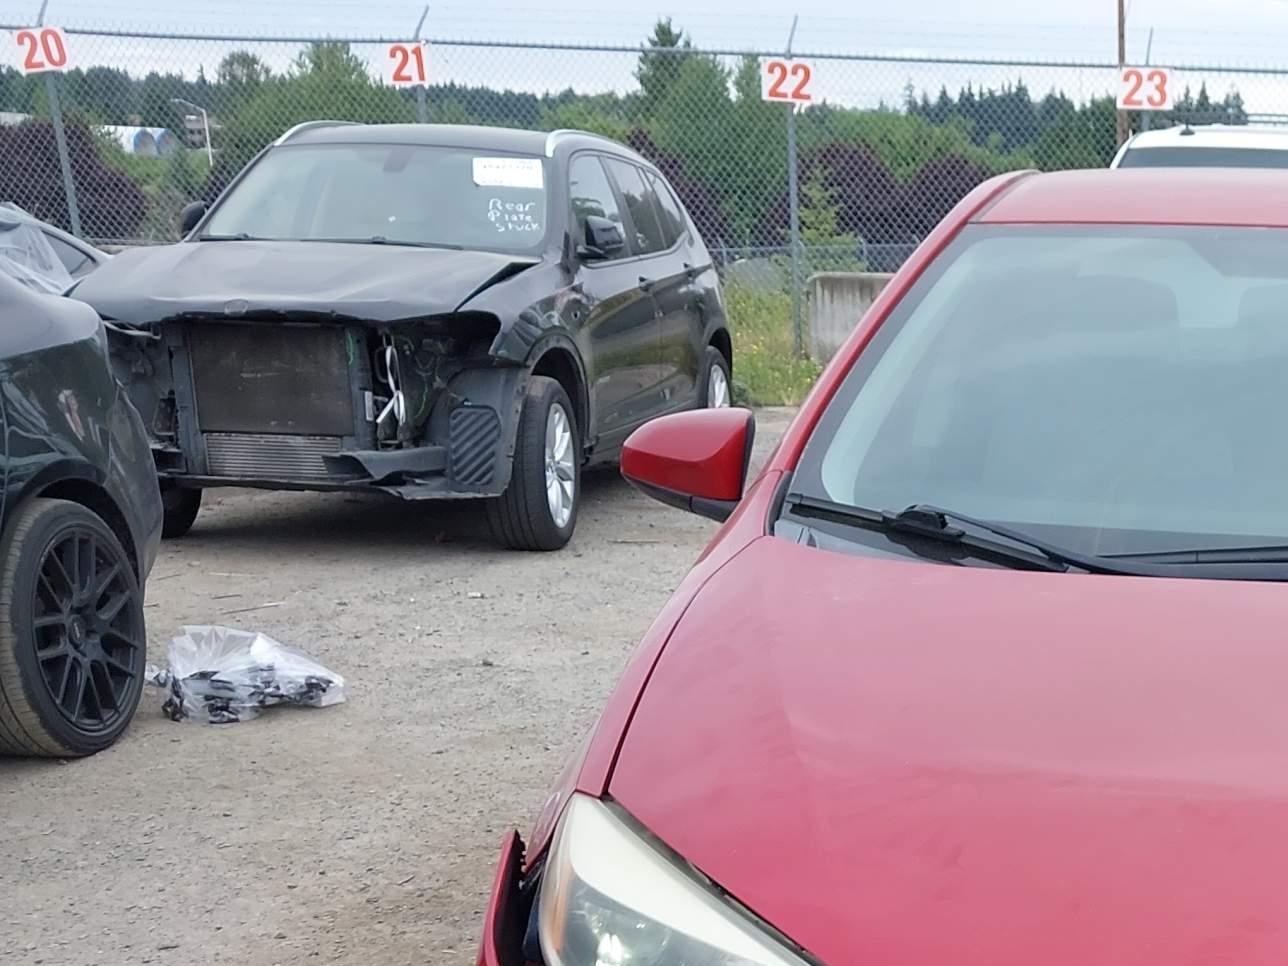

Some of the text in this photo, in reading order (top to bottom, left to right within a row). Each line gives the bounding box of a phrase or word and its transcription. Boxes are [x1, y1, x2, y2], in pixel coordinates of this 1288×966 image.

[16, 28, 66, 70] 20
[389, 45, 426, 83] 21
[767, 62, 812, 101] 22
[1122, 69, 1169, 109] 23
[488, 198, 536, 212] Rear
